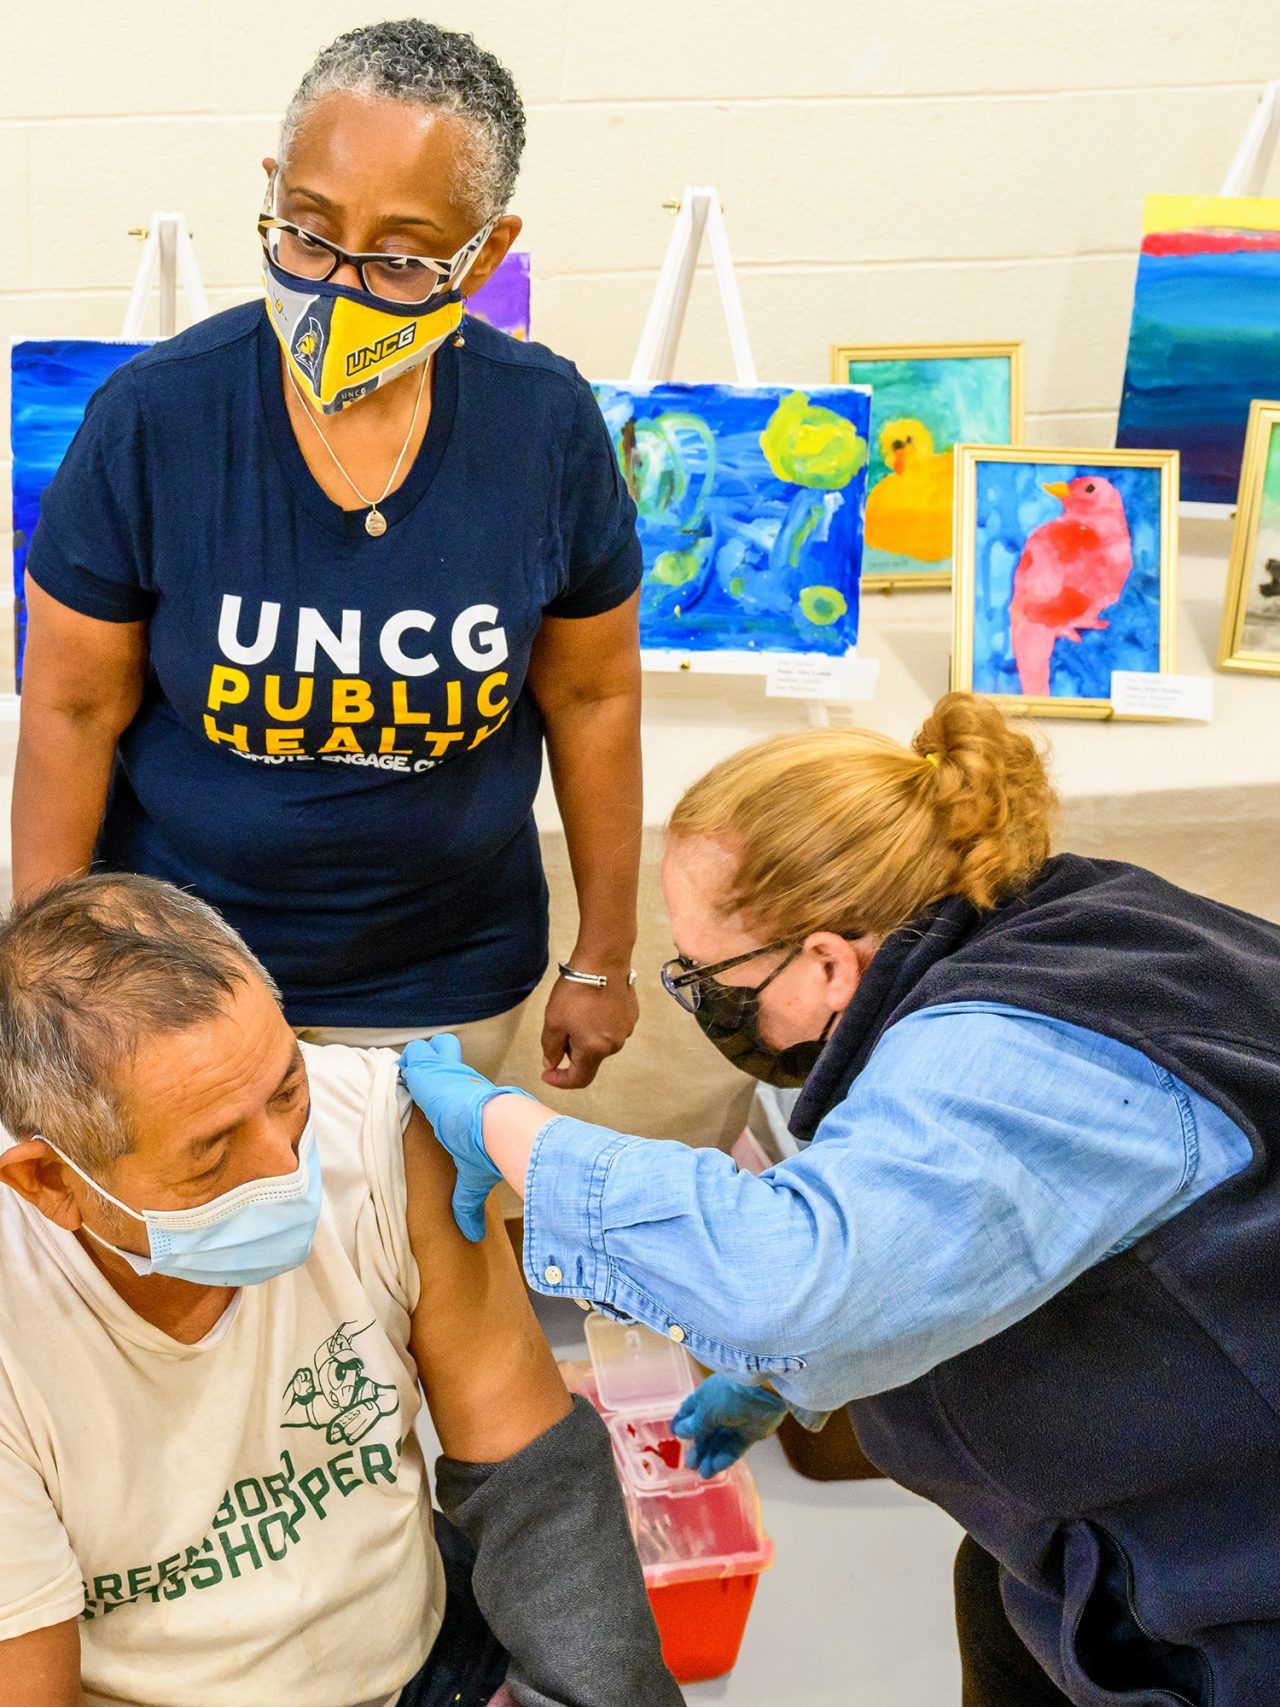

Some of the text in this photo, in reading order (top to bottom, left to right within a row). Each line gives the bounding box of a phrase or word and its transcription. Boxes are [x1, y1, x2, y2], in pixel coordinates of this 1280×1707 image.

[346, 321, 417, 377] UNCG
[341, 387, 367, 400] UNCG
[218, 594, 509, 677] UNCG
[207, 664, 509, 726] PUBLIC
